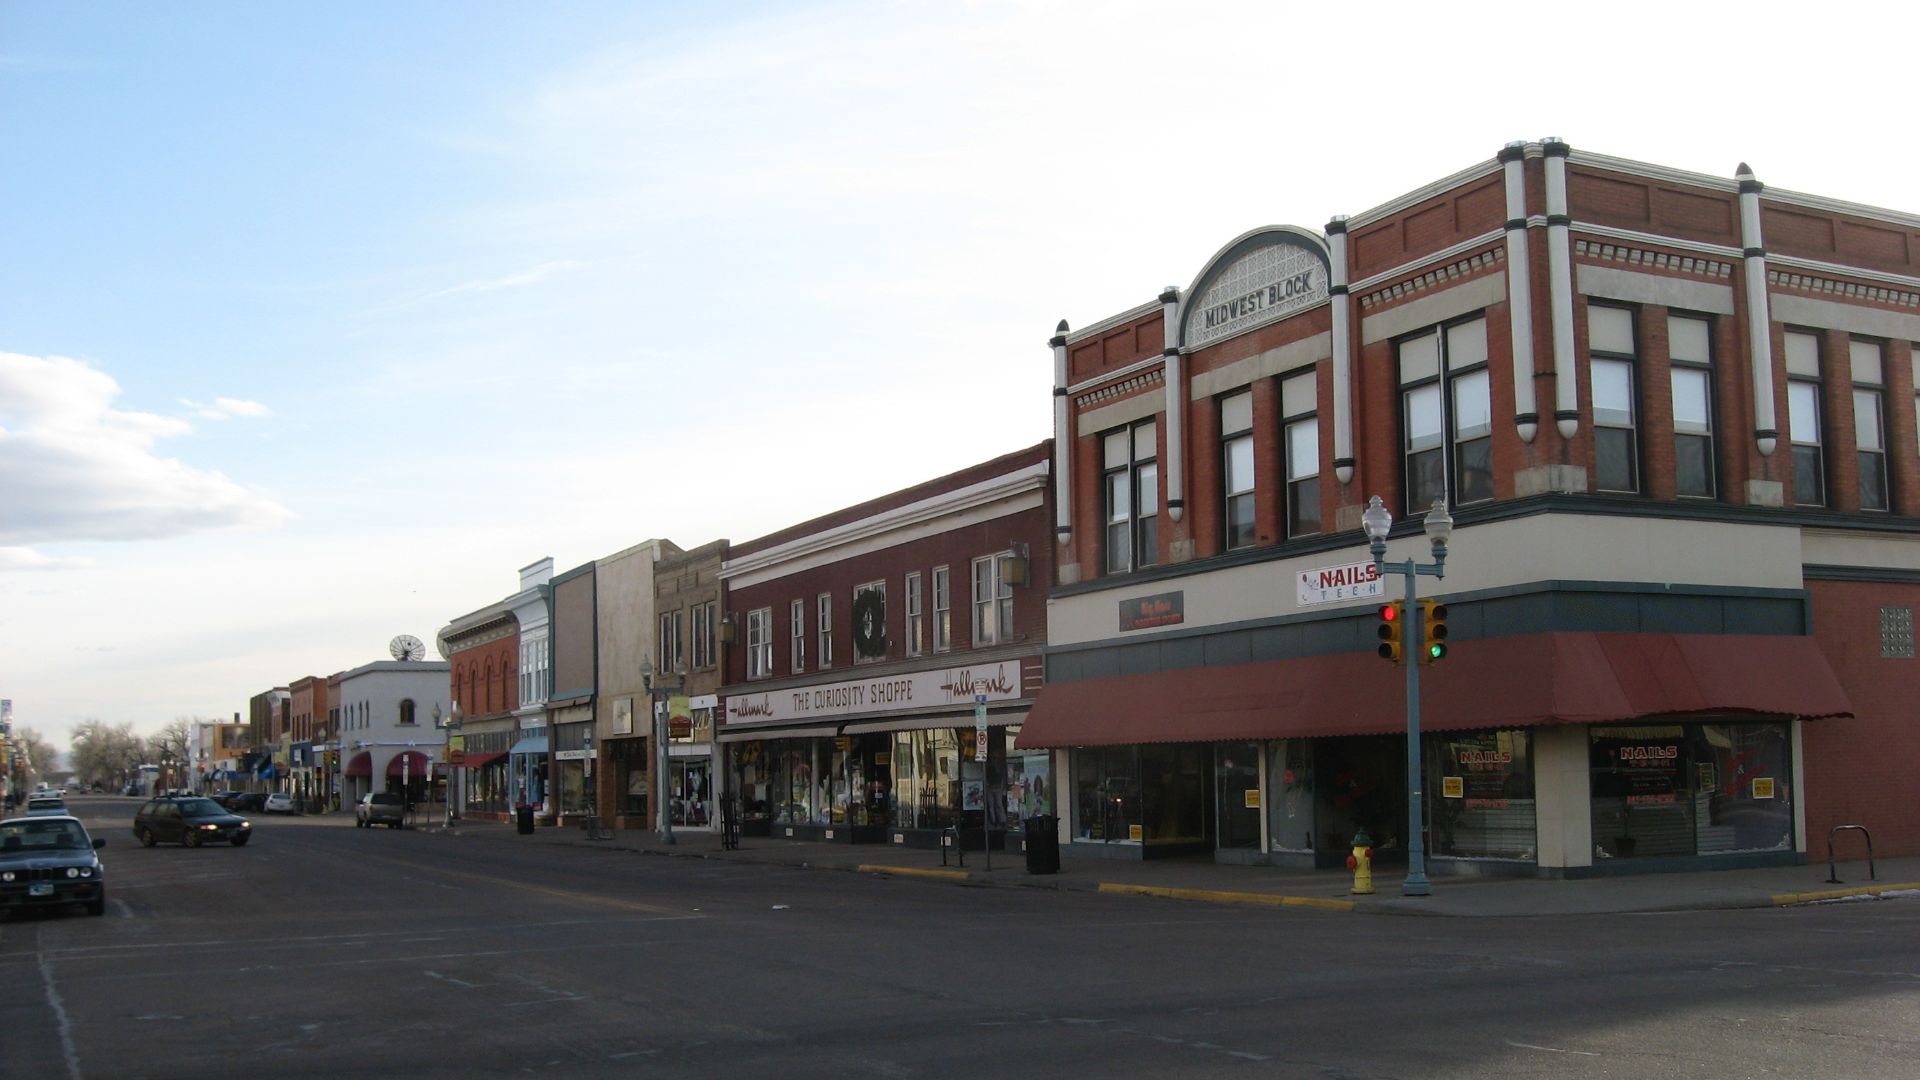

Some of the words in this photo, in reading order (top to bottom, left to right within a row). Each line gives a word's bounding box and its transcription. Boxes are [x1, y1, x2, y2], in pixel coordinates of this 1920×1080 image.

[1204, 291, 1265, 329] MIDWEST
[1268, 271, 1313, 306] BLOCK
[1319, 563, 1378, 589] NAILS
[792, 691, 810, 712] THE
[814, 685, 866, 710] CURIOSITY
[870, 679, 913, 704] SHOPPE
[1460, 750, 1512, 764] NAILS
[1620, 745, 1678, 760] NAILS
